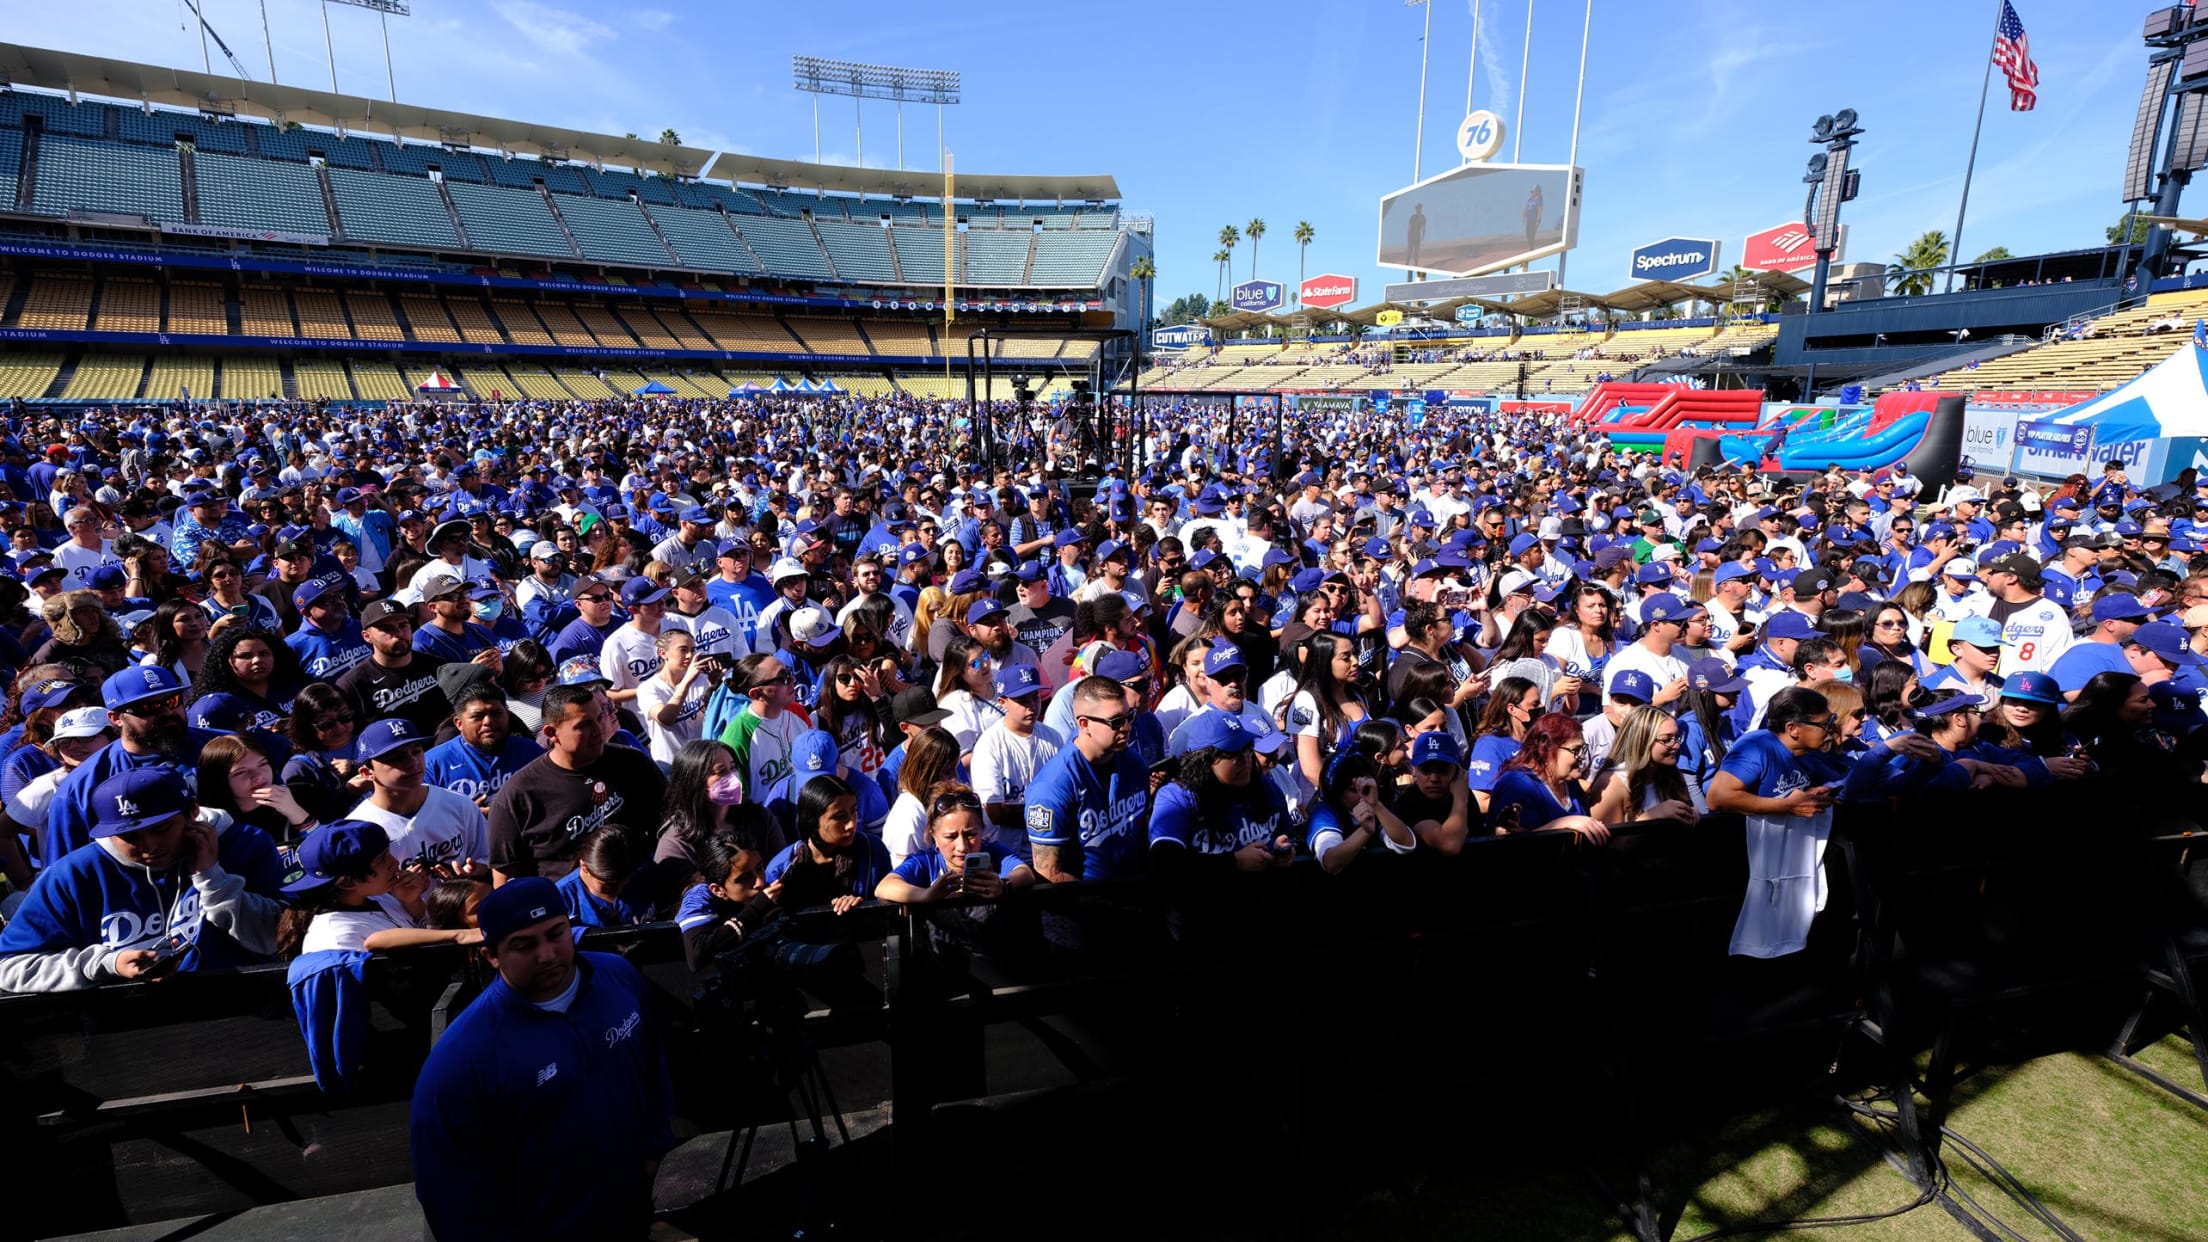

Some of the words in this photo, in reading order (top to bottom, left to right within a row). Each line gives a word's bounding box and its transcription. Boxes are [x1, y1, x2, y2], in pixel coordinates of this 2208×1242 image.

[465, 119, 491, 148] 76
[172, 227, 199, 236] BANK
[216, 230, 258, 240] AMERICA
[56, 249, 69, 257] TO
[73, 250, 115, 260] DODGER
[119, 253, 163, 263] STADIUM
[1636, 251, 1701, 272] Spectrum
[1786, 254, 1816, 264] AMERICA
[304, 265, 344, 275] WELCOME
[360, 269, 393, 278] DODGER
[395, 272, 430, 280] STADIUM
[1236, 287, 1264, 300] blue
[368, 341, 405, 349] STADIUM
[1966, 425, 1993, 445] blue
[1968, 444, 1993, 455] california
[380, 601, 394, 613] LA
[696, 627, 731, 651] dgers
[1019, 626, 1064, 641] CHAMPIONS
[2005, 621, 2045, 641] dgers
[1211, 645, 1240, 664] Dodgers
[2019, 641, 2036, 661] 8
[312, 644, 373, 677] Dodgers
[1019, 669, 1033, 684] LA
[1623, 673, 1638, 687] LA
[372, 674, 439, 712] Dodgers
[387, 720, 408, 737] LA
[1427, 735, 1441, 750] LA
[114, 794, 140, 817] LA
[565, 791, 625, 841] Dodgers
[1079, 790, 1147, 847] Dodgers
[605, 1008, 641, 1048] Dodgers
